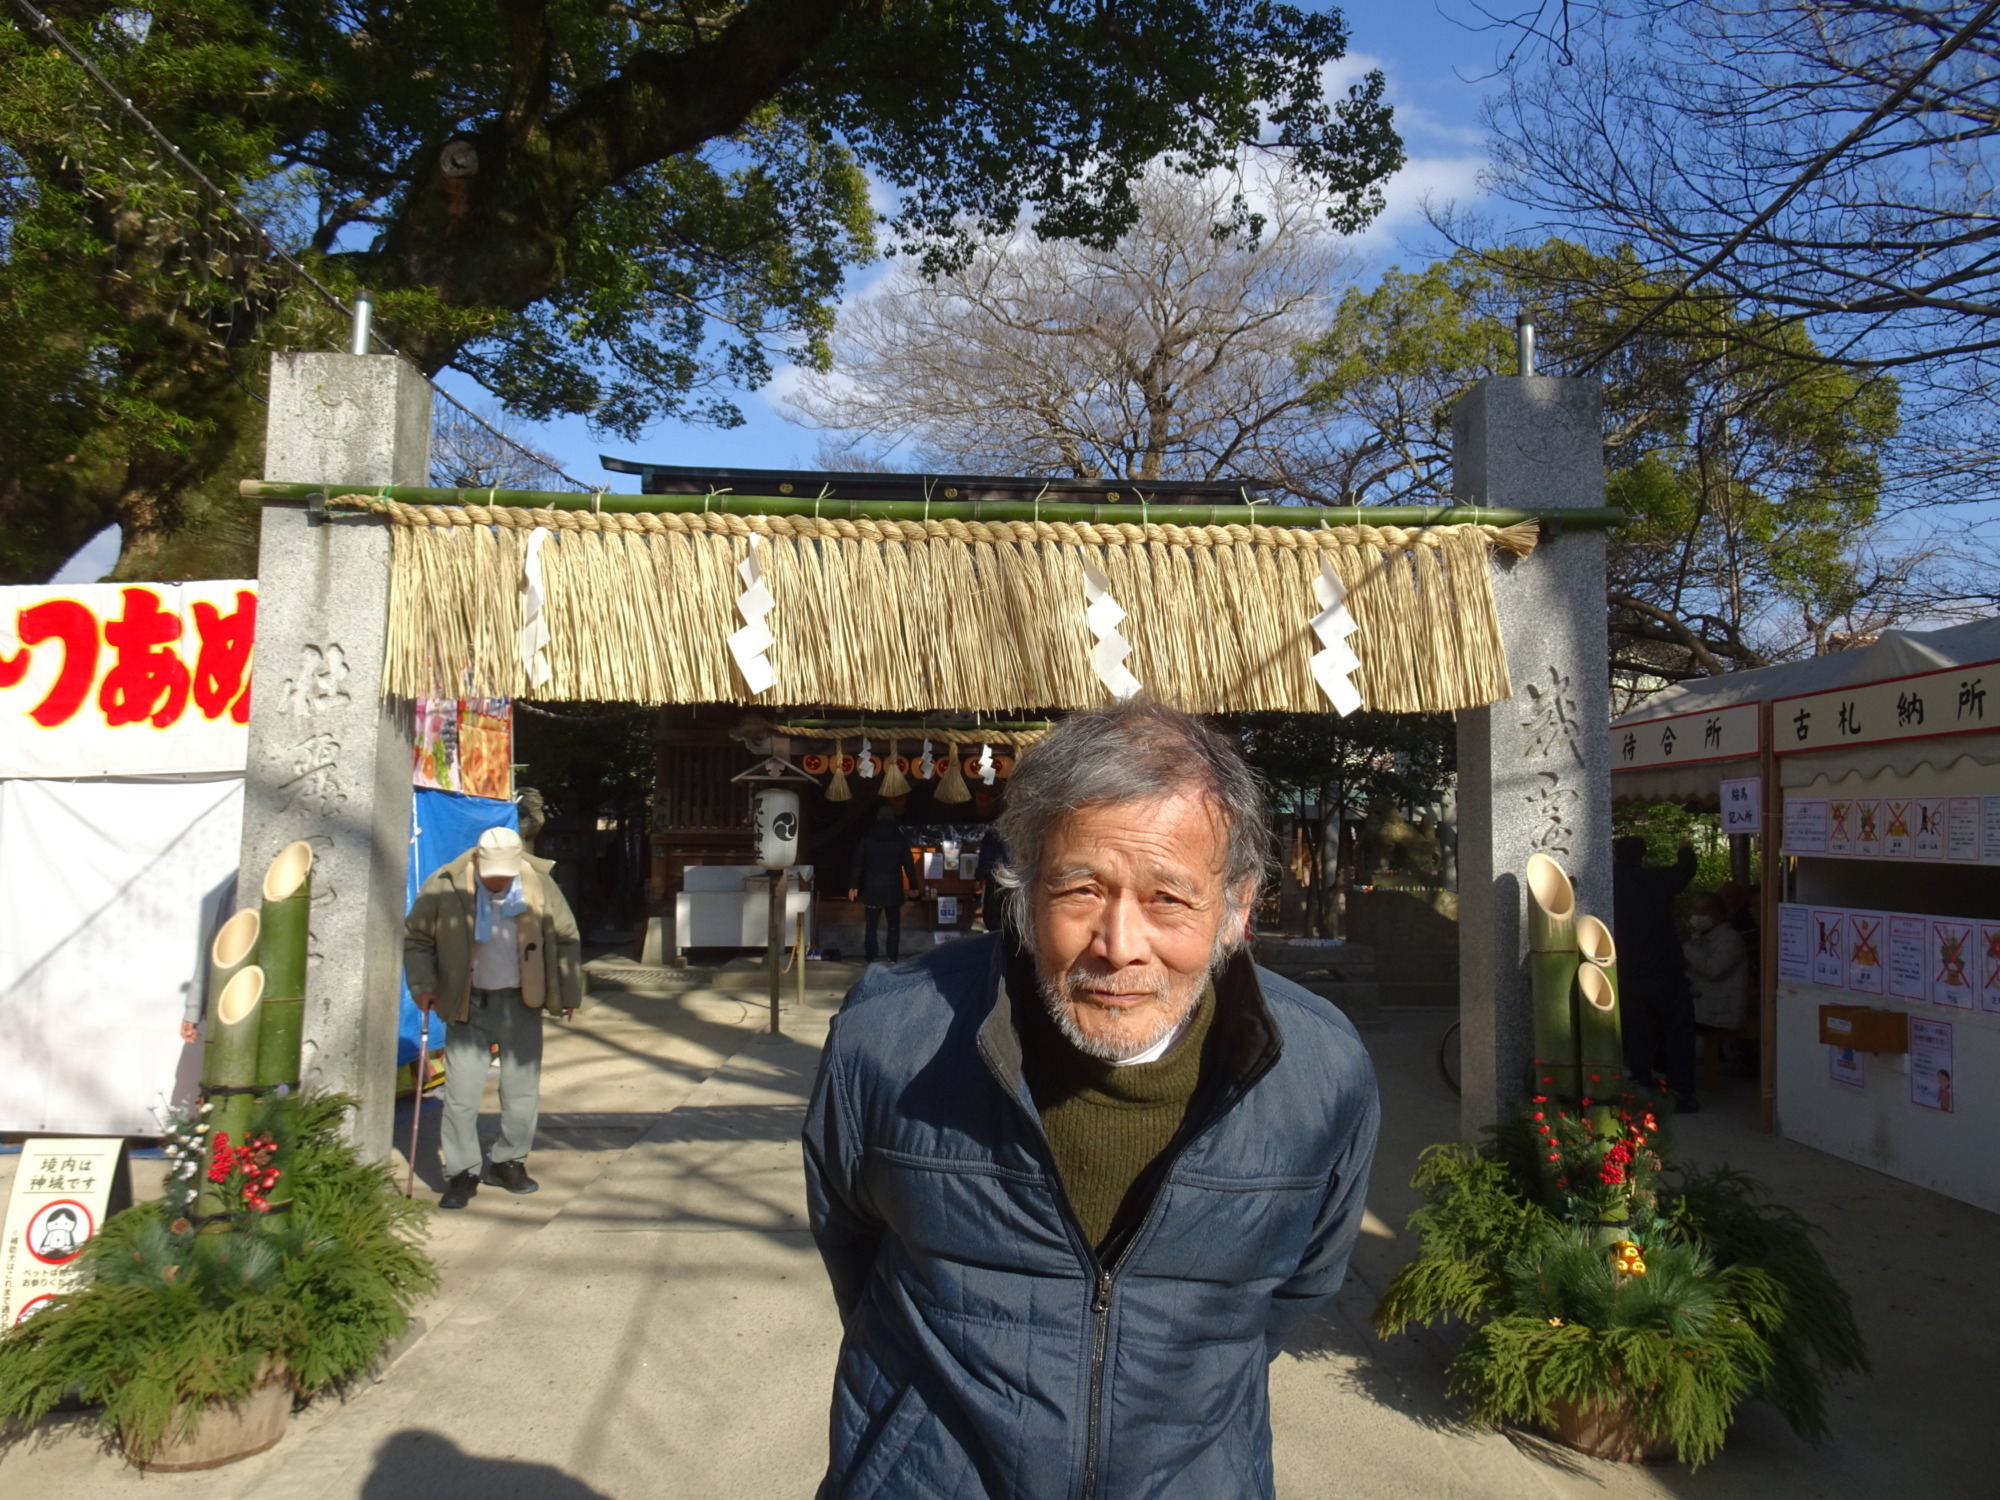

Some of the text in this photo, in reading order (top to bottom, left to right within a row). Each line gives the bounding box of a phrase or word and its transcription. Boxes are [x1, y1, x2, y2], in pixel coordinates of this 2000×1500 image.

[1793, 678, 1987, 742] 古札納所
[1622, 716, 1723, 761] 待合所
[1731, 787, 1748, 801] 絵馬
[1728, 810, 1752, 824] 記入所
[40, 1157, 92, 1173] 境内は
[30, 1174, 97, 1190] 神域です
